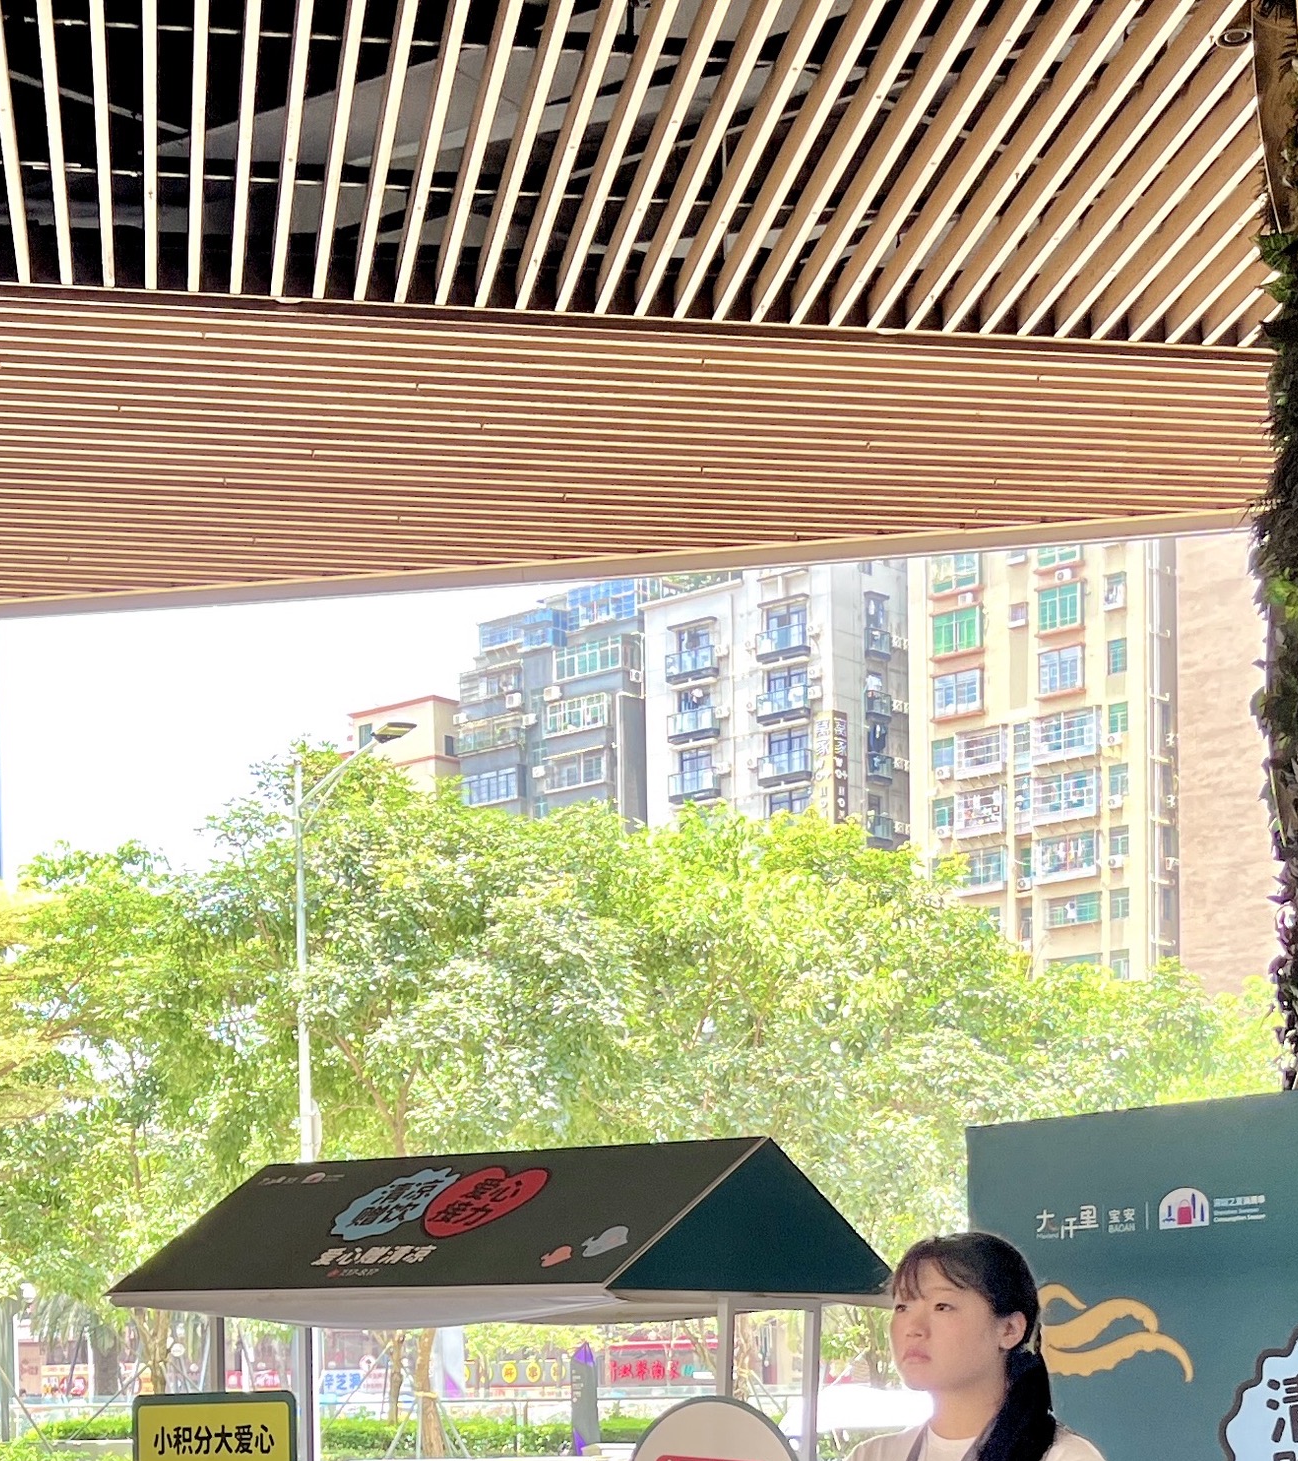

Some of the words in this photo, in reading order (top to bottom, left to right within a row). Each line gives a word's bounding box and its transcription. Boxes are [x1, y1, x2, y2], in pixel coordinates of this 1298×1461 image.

[371, 1179, 444, 1205] 清凉
[462, 1178, 524, 1202] 爱心
[345, 1203, 420, 1228] 赠饮
[428, 1200, 494, 1226] 接力
[1036, 1205, 1099, 1240] 大仟里
[1108, 1208, 1135, 1223] 宝安
[311, 1244, 437, 1266] 爱心赠清凉
[153, 1424, 275, 1455] 小积分大爱心
